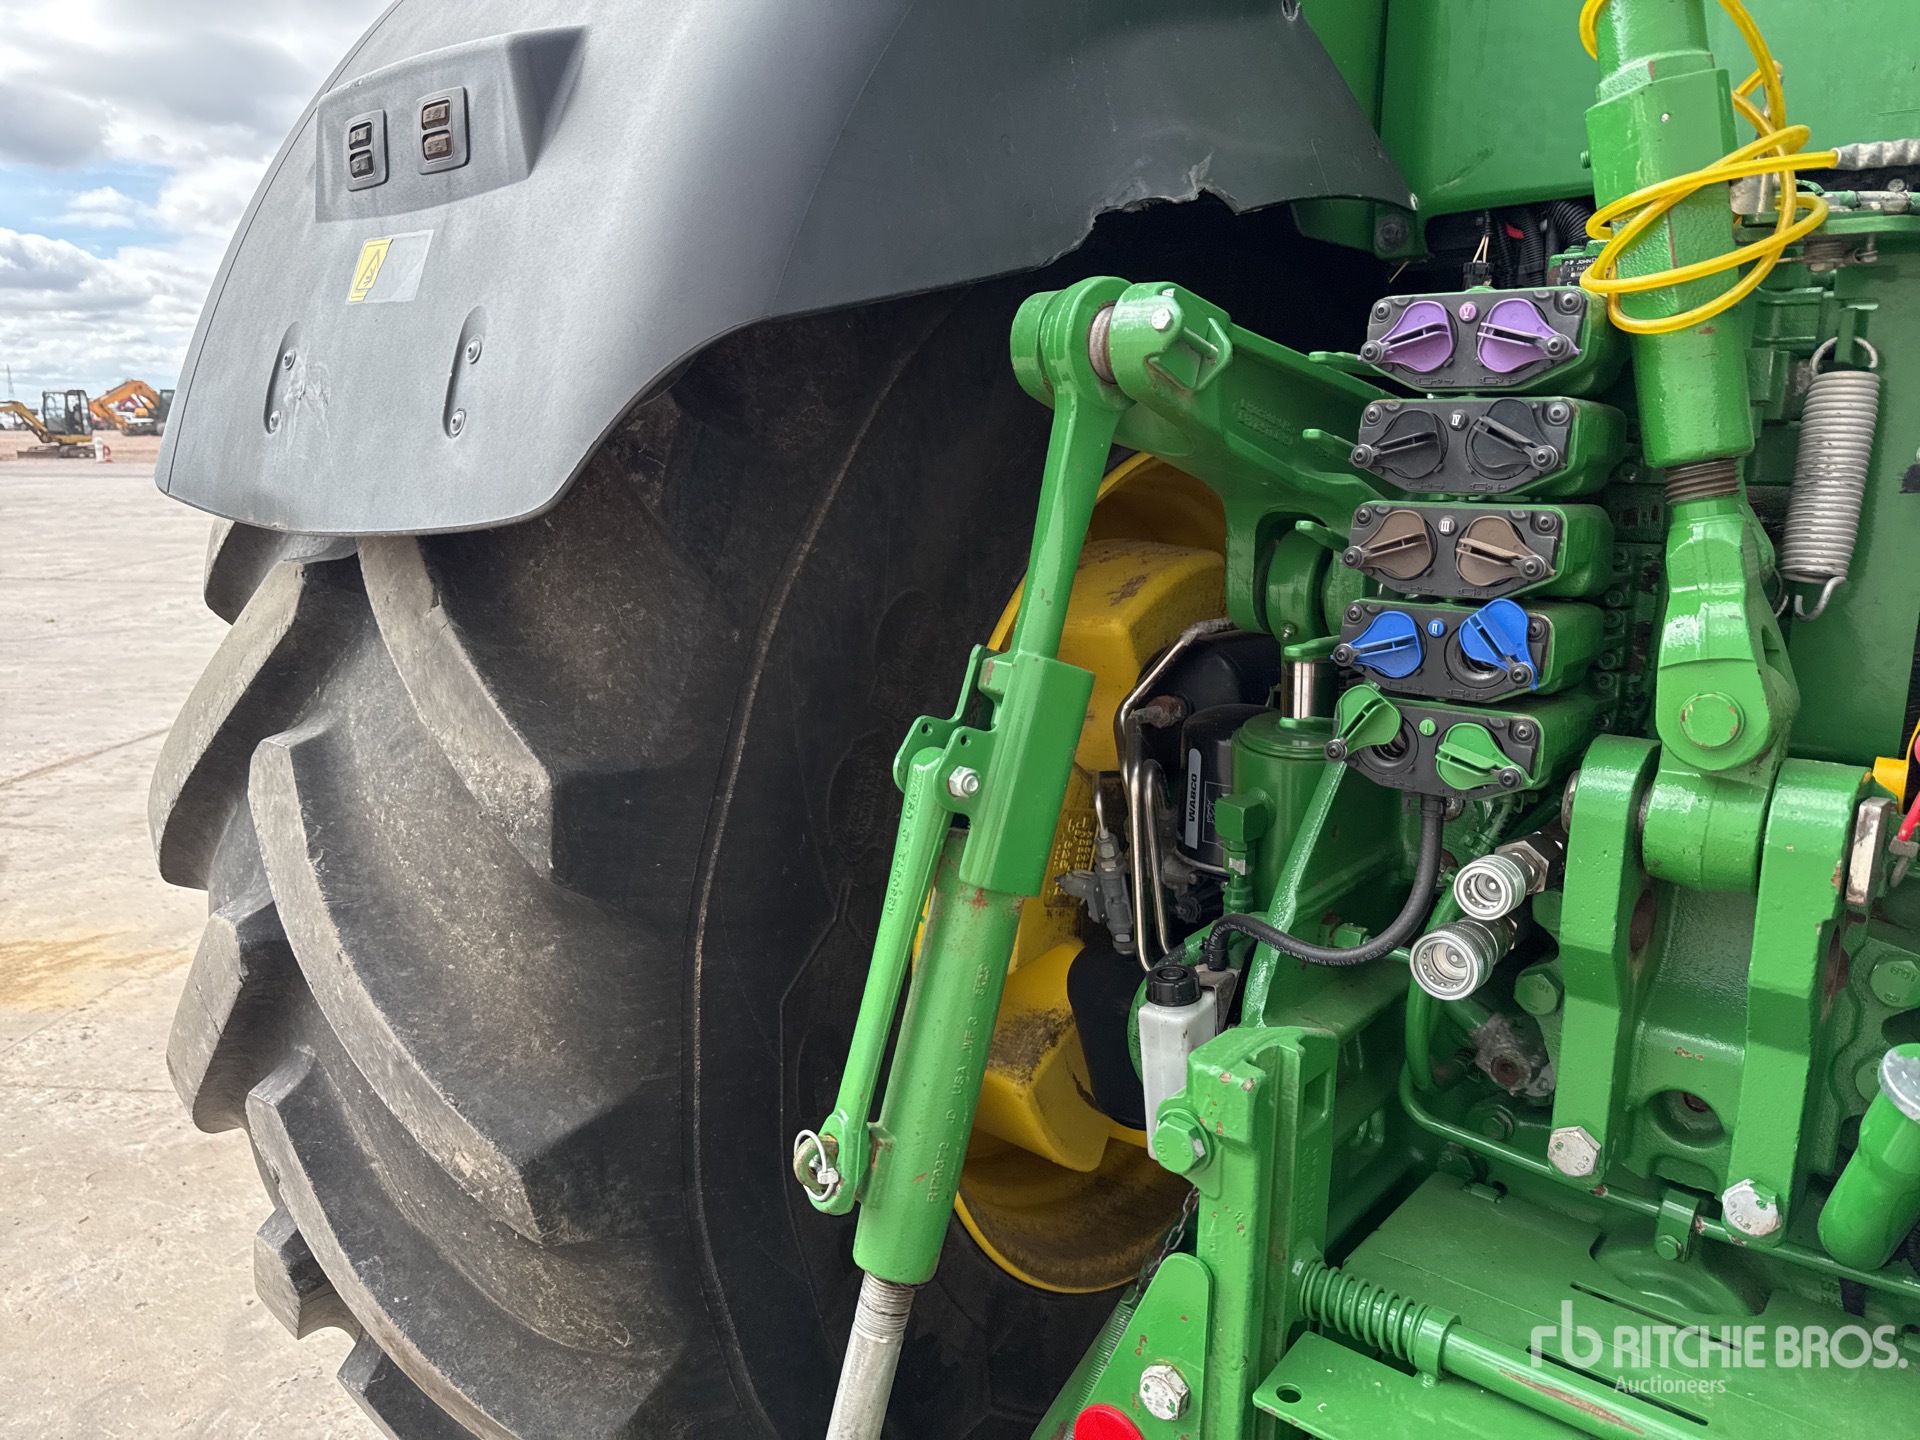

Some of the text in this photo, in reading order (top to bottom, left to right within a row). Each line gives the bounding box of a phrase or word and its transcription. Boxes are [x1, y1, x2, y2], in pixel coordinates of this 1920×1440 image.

[1462, 306, 1472, 319] V
[1440, 520, 1450, 532] III
[1188, 773, 1198, 823] WABCO
